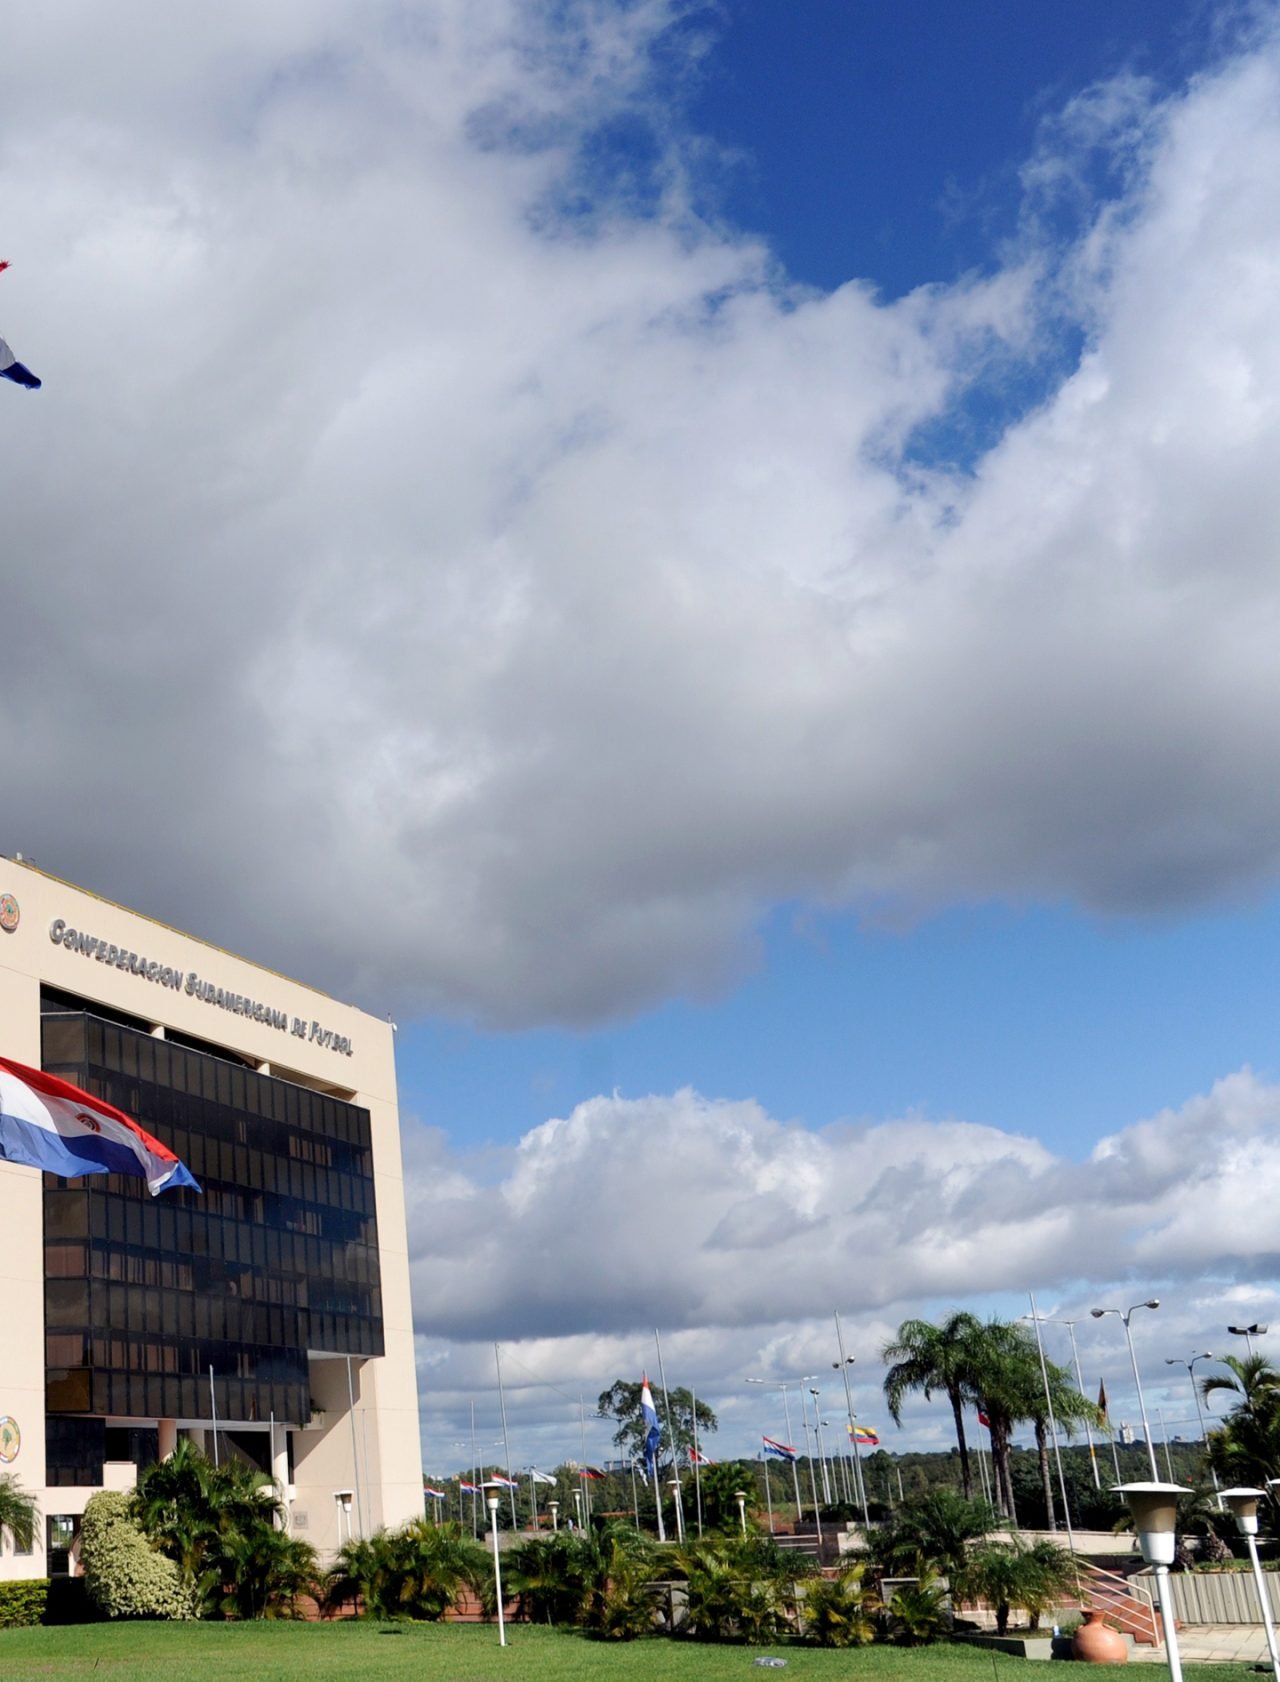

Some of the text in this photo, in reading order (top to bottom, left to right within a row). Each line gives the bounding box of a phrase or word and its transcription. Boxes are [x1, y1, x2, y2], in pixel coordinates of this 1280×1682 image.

[49, 918, 353, 1057] CONFEDERACION SUDAMERICANA DE FUTBOL
